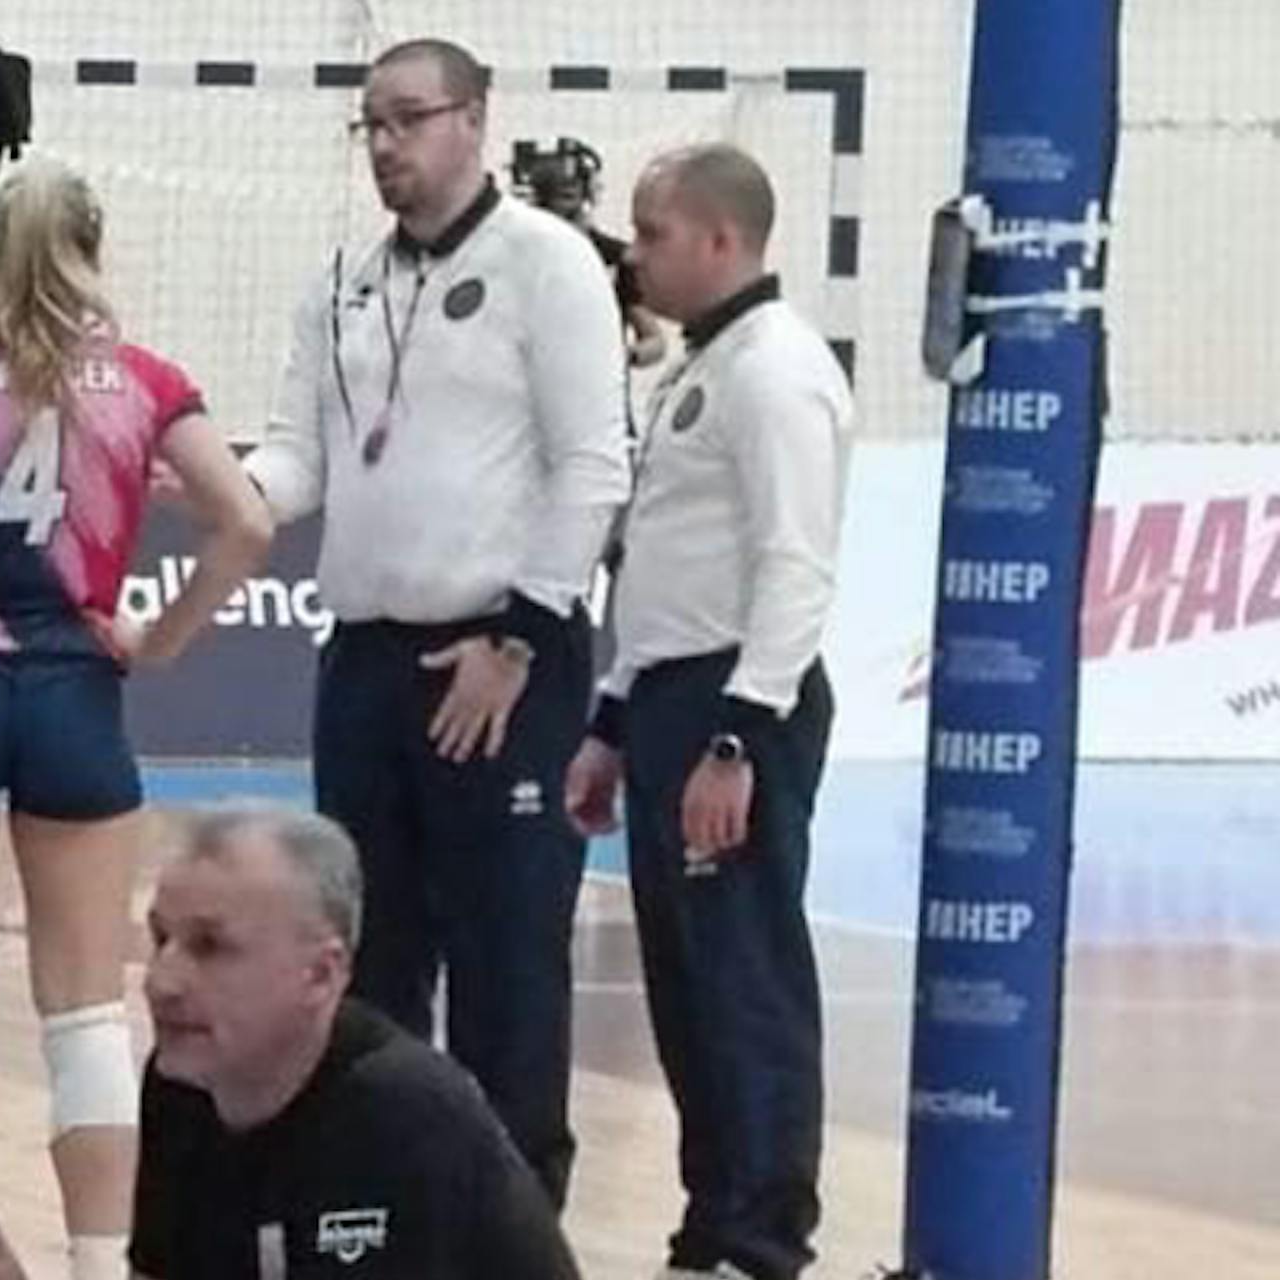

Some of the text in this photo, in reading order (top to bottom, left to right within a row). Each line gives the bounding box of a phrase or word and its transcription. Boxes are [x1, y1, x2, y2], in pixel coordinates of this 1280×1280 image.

[987, 389, 1061, 431] HEP
[977, 562, 1051, 602] HEP
[966, 731, 1042, 774] HEP
[958, 903, 1035, 945] HEP
